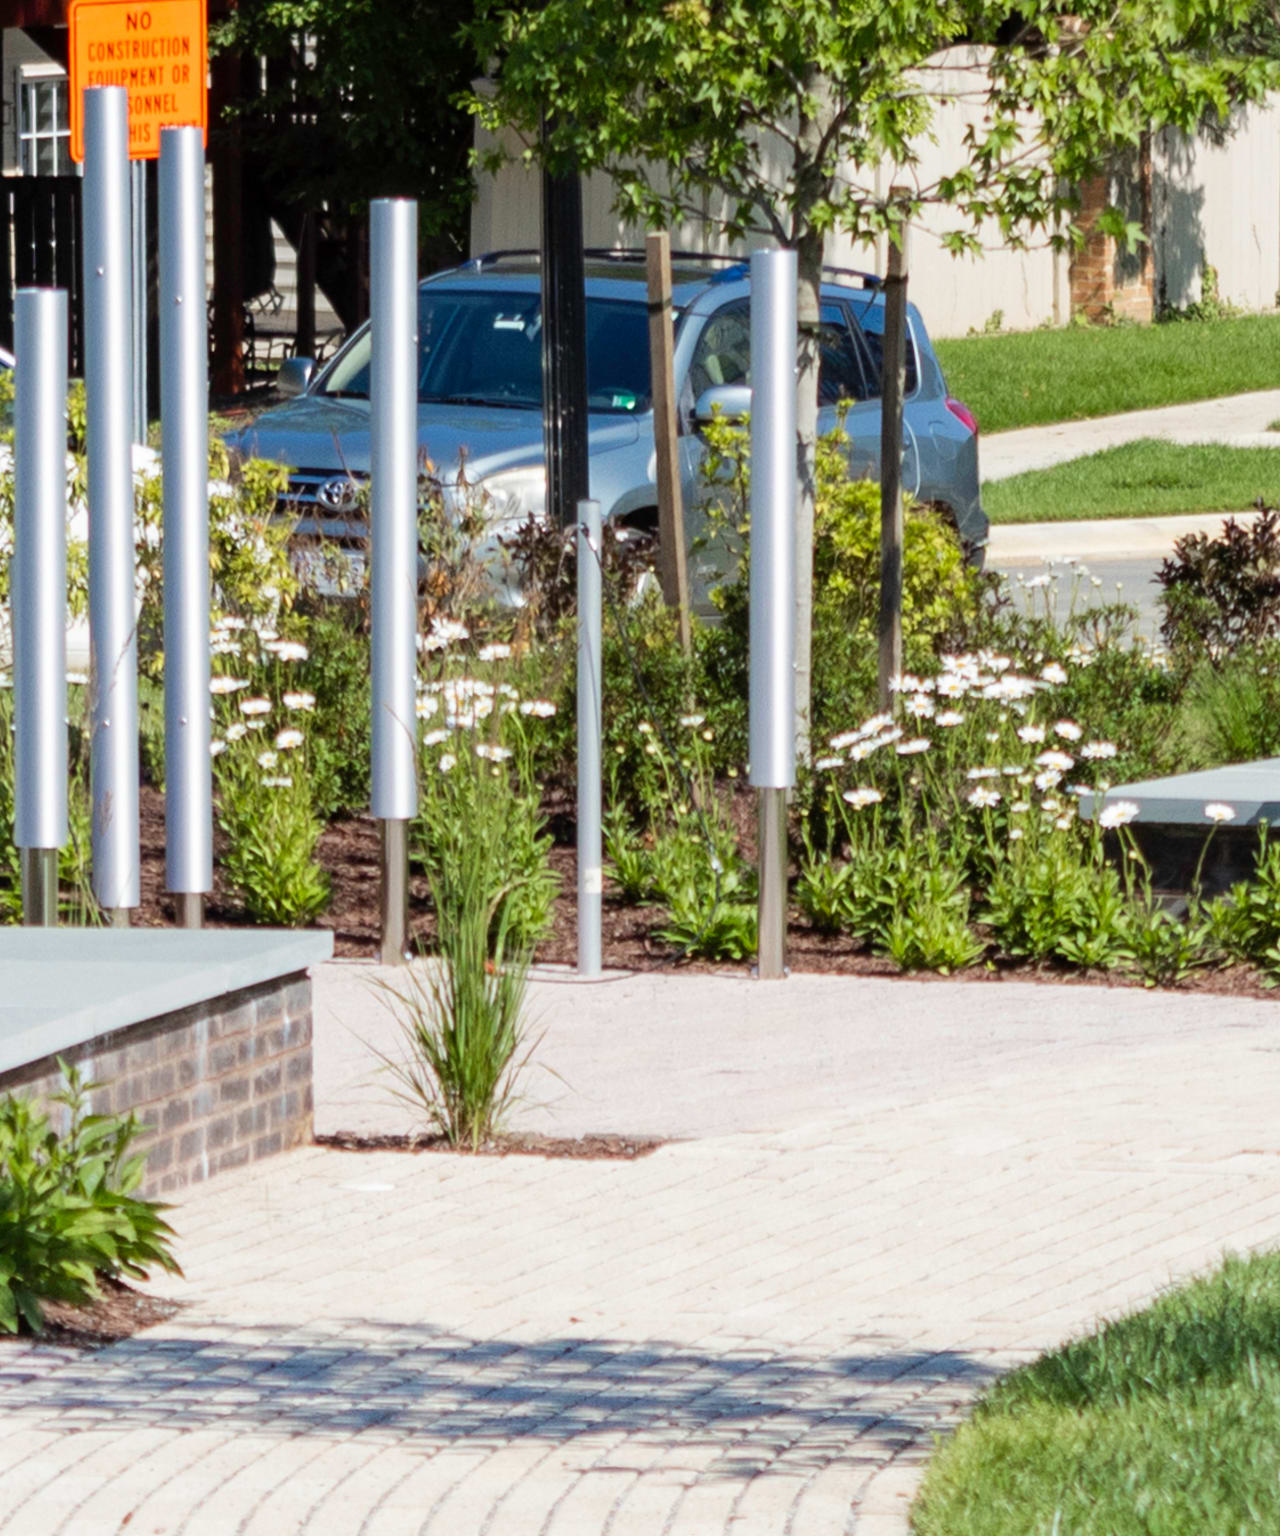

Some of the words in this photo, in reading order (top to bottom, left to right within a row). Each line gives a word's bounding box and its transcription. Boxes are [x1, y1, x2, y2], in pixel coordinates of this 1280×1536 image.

[126, 11, 152, 32] NO
[87, 36, 190, 63] CONSTRUCTION
[172, 64, 190, 85] OR
